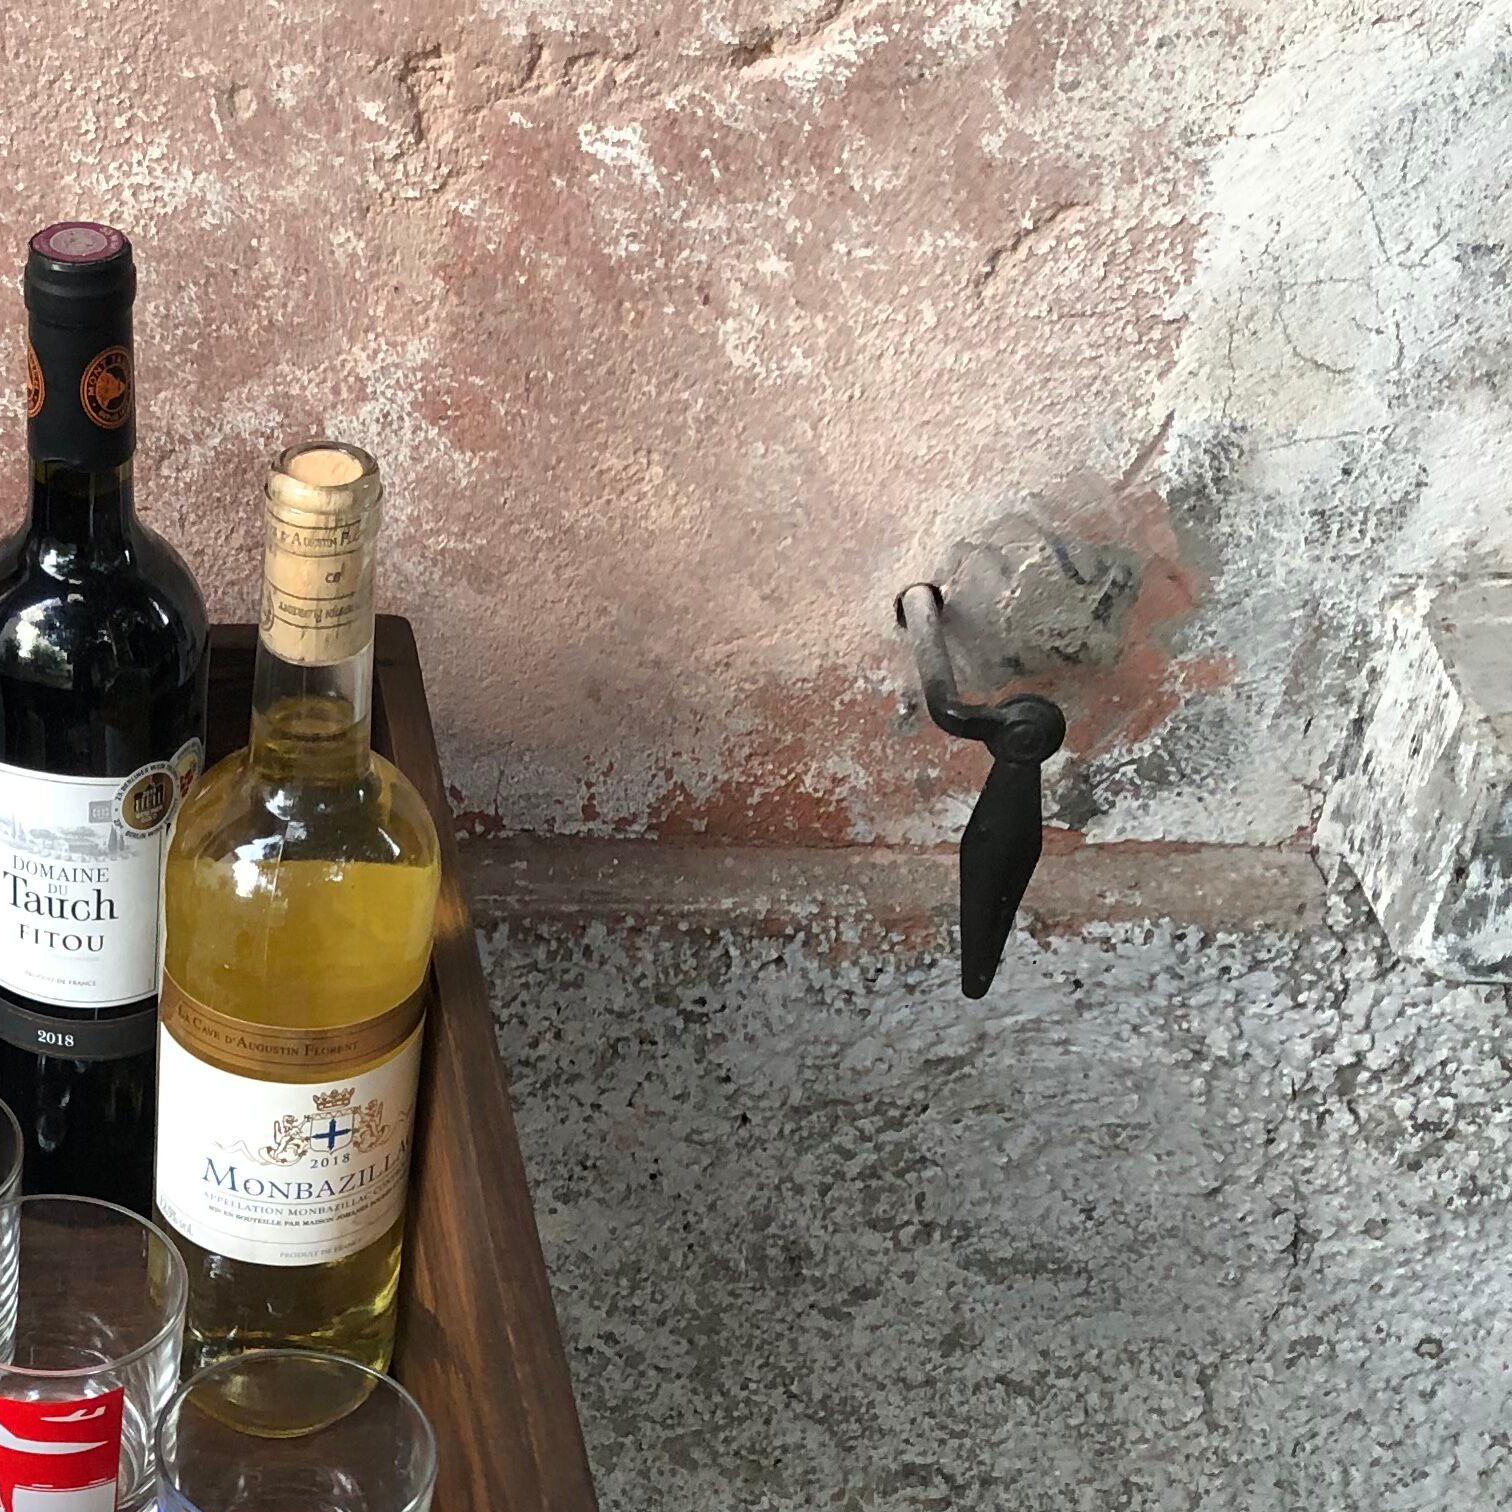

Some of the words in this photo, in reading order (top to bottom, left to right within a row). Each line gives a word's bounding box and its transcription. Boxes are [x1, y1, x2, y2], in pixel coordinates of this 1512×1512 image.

[12, 855, 109, 883] DOMAINE
[2, 870, 119, 921] Tauch
[48, 883, 68, 896] DU
[19, 923, 105, 952] FITOU
[37, 1029, 75, 1047] 2018
[193, 1017, 220, 1040] CAVE
[310, 1152, 350, 1169] 2018
